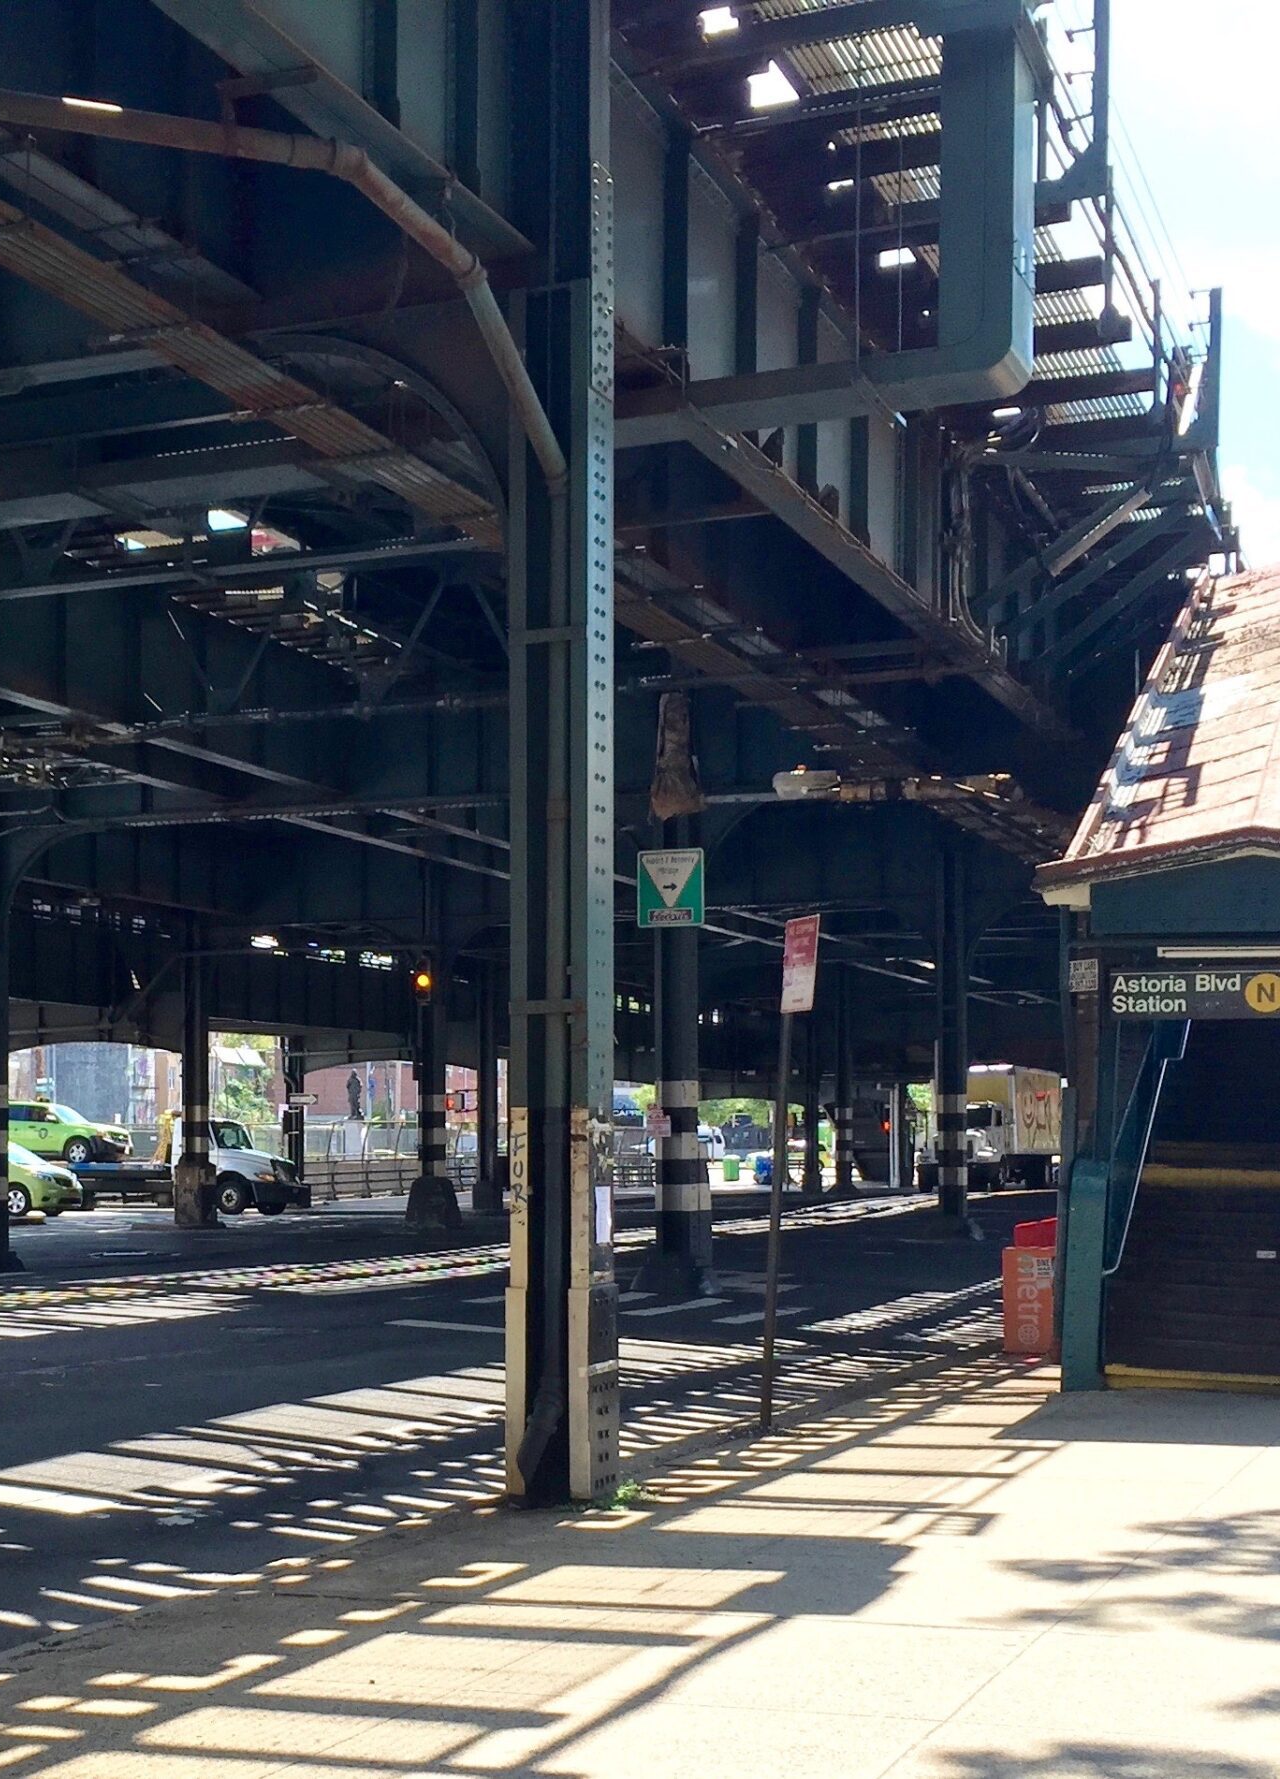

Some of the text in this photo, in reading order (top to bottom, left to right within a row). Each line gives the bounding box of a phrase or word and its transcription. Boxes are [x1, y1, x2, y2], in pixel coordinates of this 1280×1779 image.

[1112, 975, 1187, 993] Astoria
[1195, 973, 1241, 992] Blvd
[1257, 982, 1276, 1003] N
[1111, 995, 1187, 1013] Station
